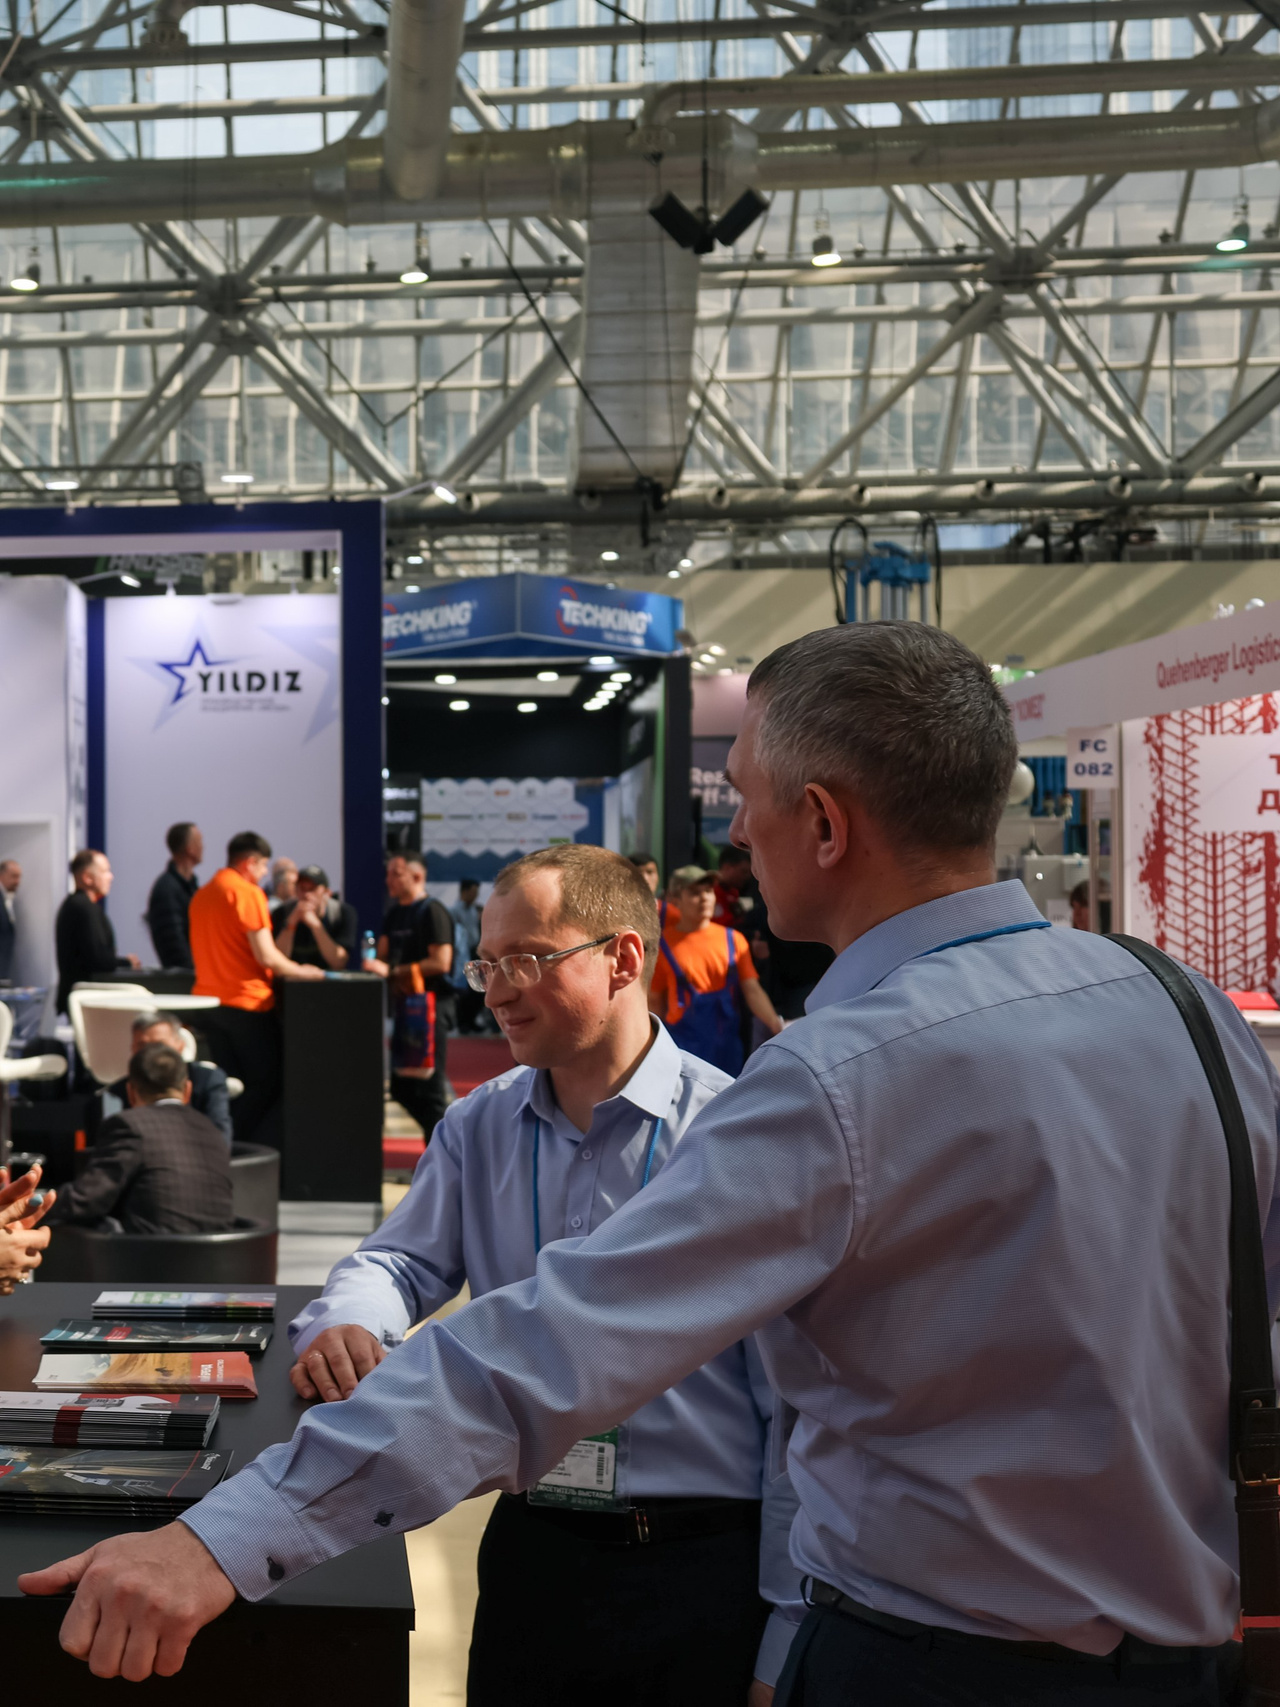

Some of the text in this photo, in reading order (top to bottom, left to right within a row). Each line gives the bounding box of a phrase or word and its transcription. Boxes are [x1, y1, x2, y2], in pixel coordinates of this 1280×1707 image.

[560, 598, 649, 635] TECHKING
[198, 670, 302, 693] YILDIZ
[1079, 739, 1108, 753] FC
[1074, 762, 1114, 777] 082
